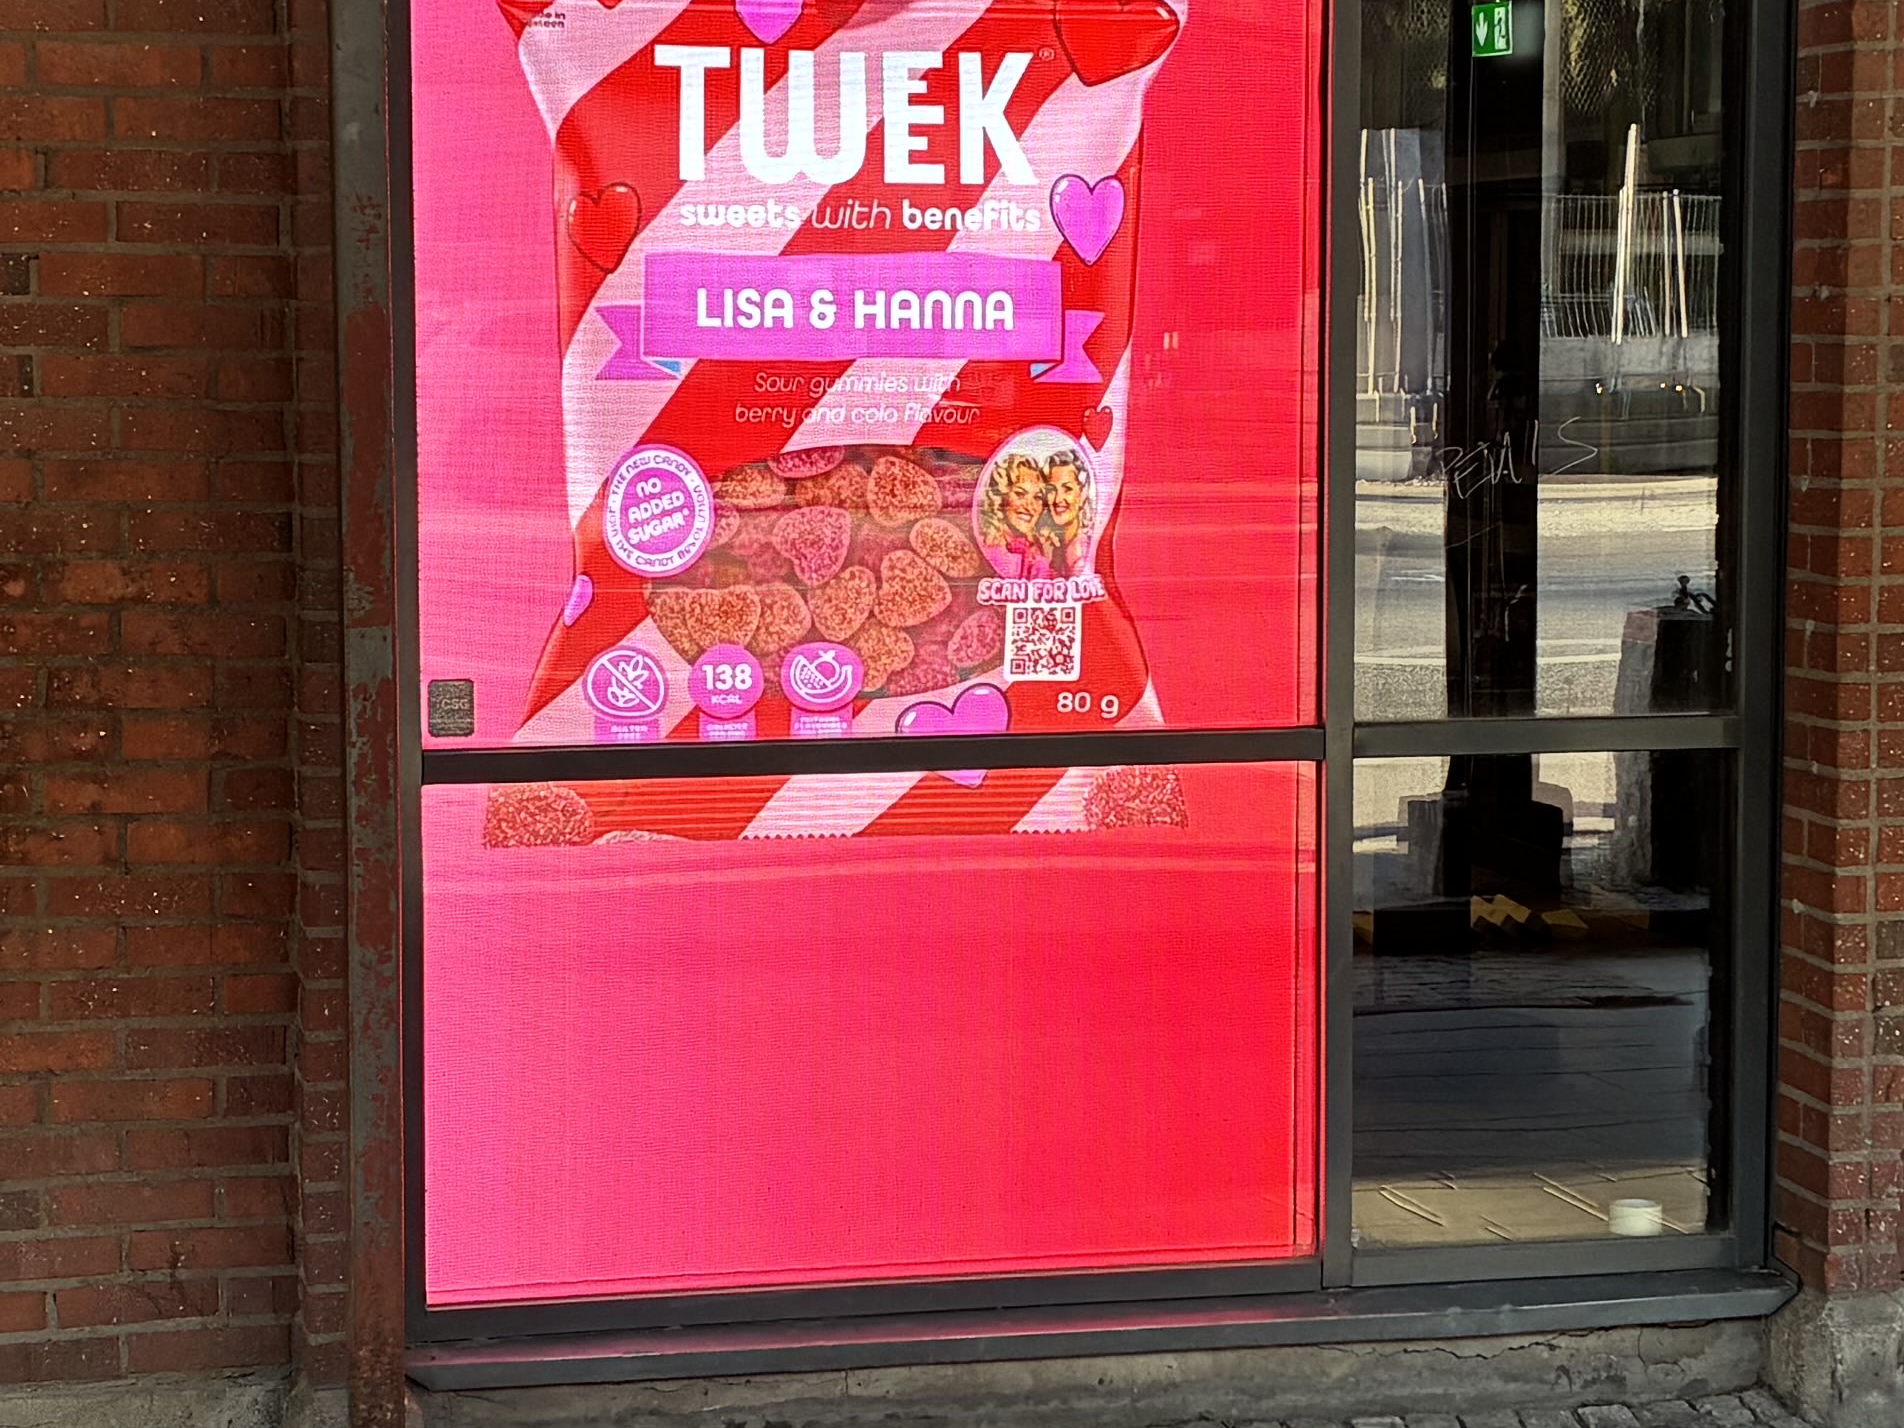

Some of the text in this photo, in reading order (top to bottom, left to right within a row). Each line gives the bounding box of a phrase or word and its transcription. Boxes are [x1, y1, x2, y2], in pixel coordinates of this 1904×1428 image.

[653, 45, 1037, 185] TWEK
[679, 199, 1041, 232] sweets with benefits
[696, 288, 1015, 331] LISA & HANNA
[754, 372, 961, 398] Sour gummies with
[735, 403, 980, 428] berry and cola flavour
[636, 477, 662, 498] NO
[627, 491, 685, 524] ADDED
[978, 579, 1028, 604] SCAN
[1032, 580, 1067, 604] FOR
[702, 664, 753, 691] 138
[1056, 691, 1119, 719] 80 g
